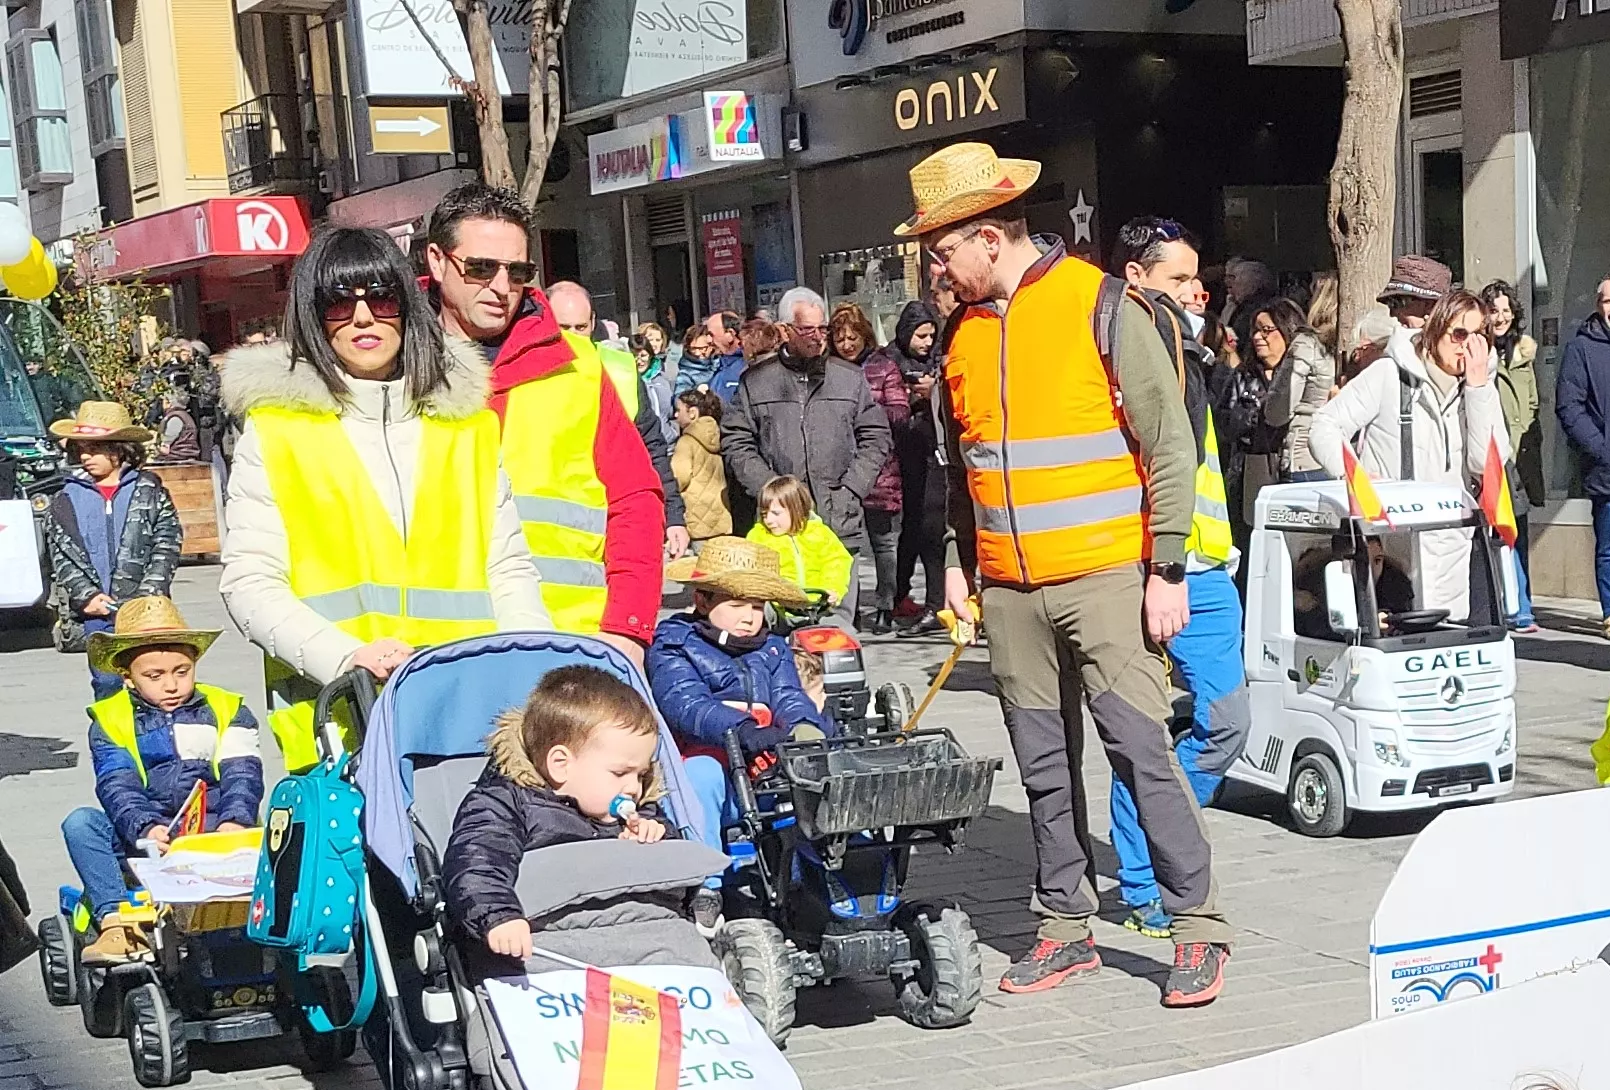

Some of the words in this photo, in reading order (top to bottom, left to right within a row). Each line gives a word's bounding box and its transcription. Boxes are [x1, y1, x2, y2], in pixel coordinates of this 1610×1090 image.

[715, 146, 760, 158] NAUTALIA
[1269, 509, 1332, 525] CHAMPION
[1404, 649, 1492, 673] GAEL
[1393, 966, 1422, 979] SALUD
[1422, 958, 1475, 974] FABRICANDO
[1391, 993, 1421, 1007] años
